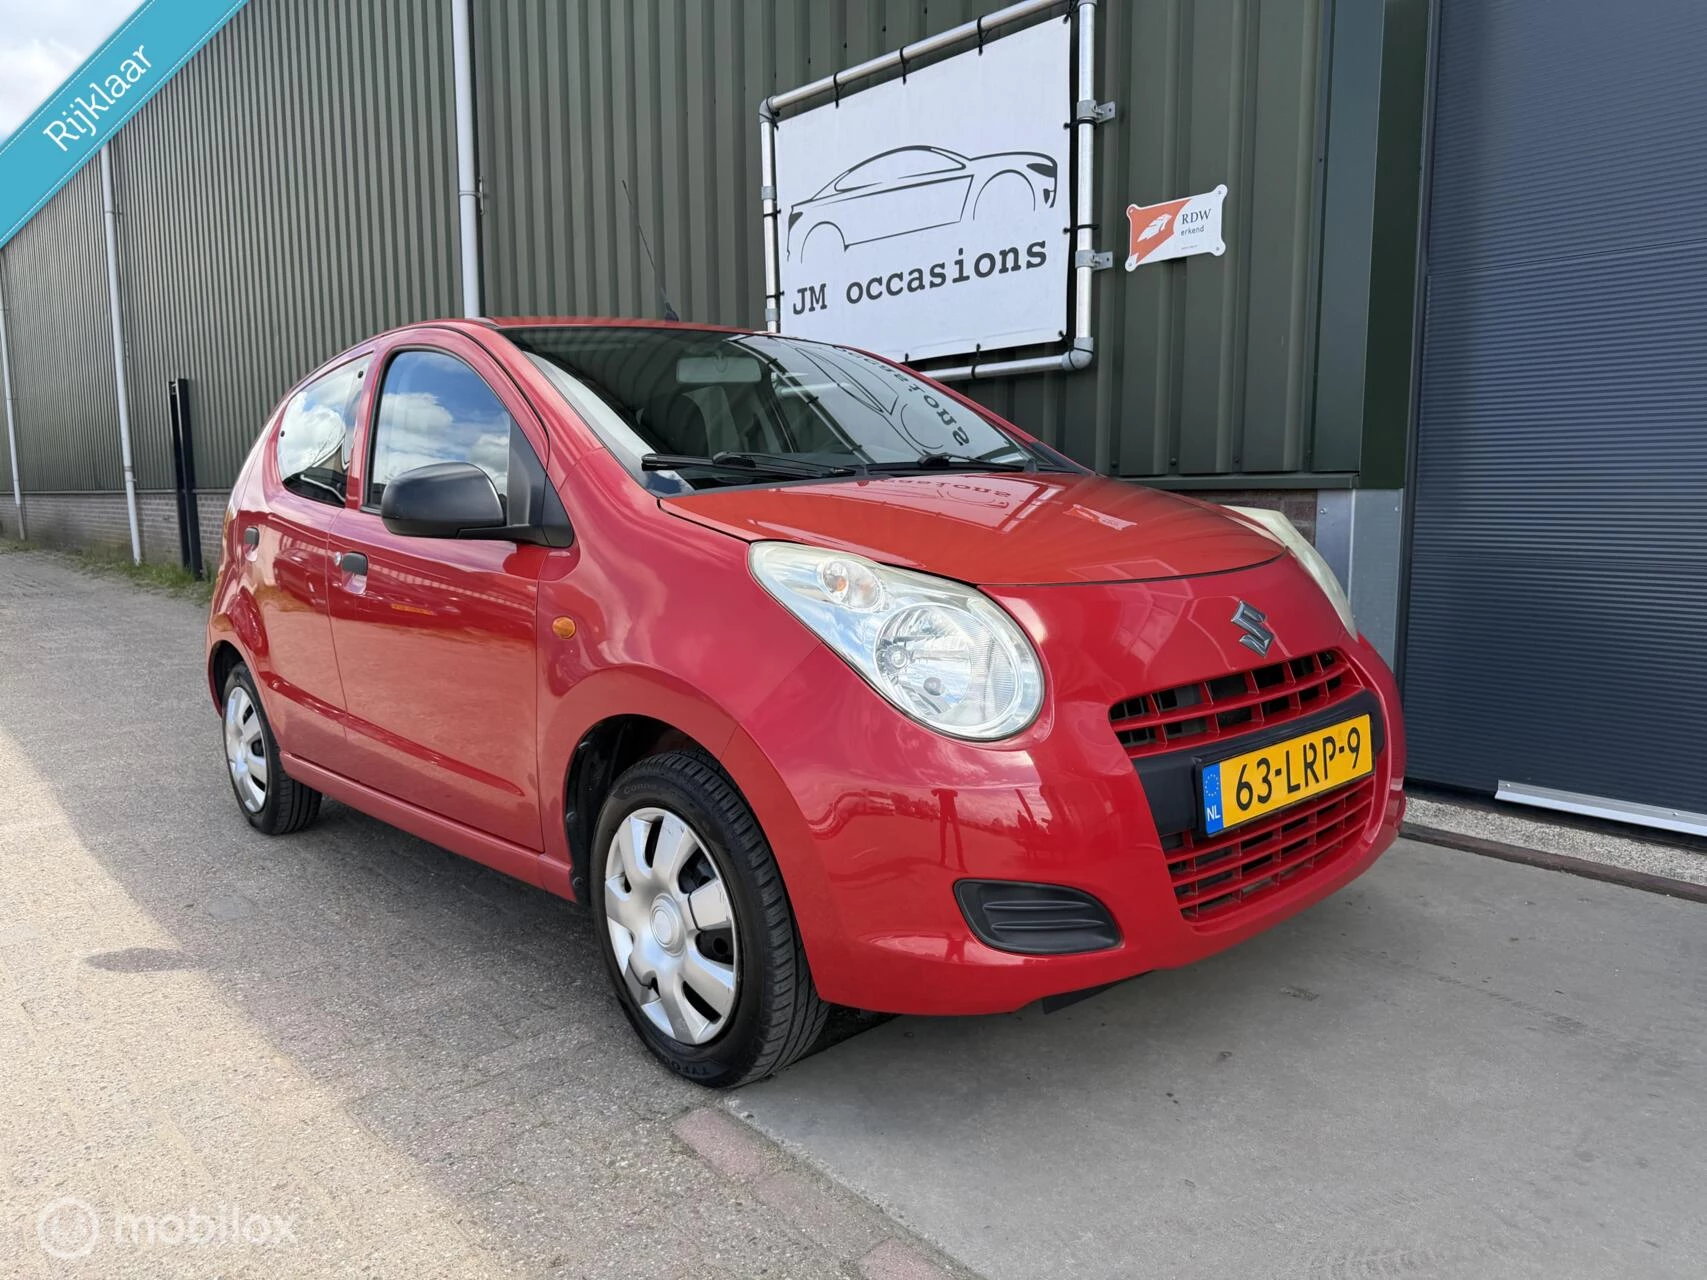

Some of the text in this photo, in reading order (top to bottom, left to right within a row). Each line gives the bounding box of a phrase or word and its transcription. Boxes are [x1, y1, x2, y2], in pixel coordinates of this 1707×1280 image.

[1182, 208, 1212, 225] RDW
[1181, 225, 1205, 236] erkend
[793, 240, 1047, 316] JM occasions
[1236, 727, 1361, 811] 63-LRP-9
[1207, 805, 1221, 821] NL
